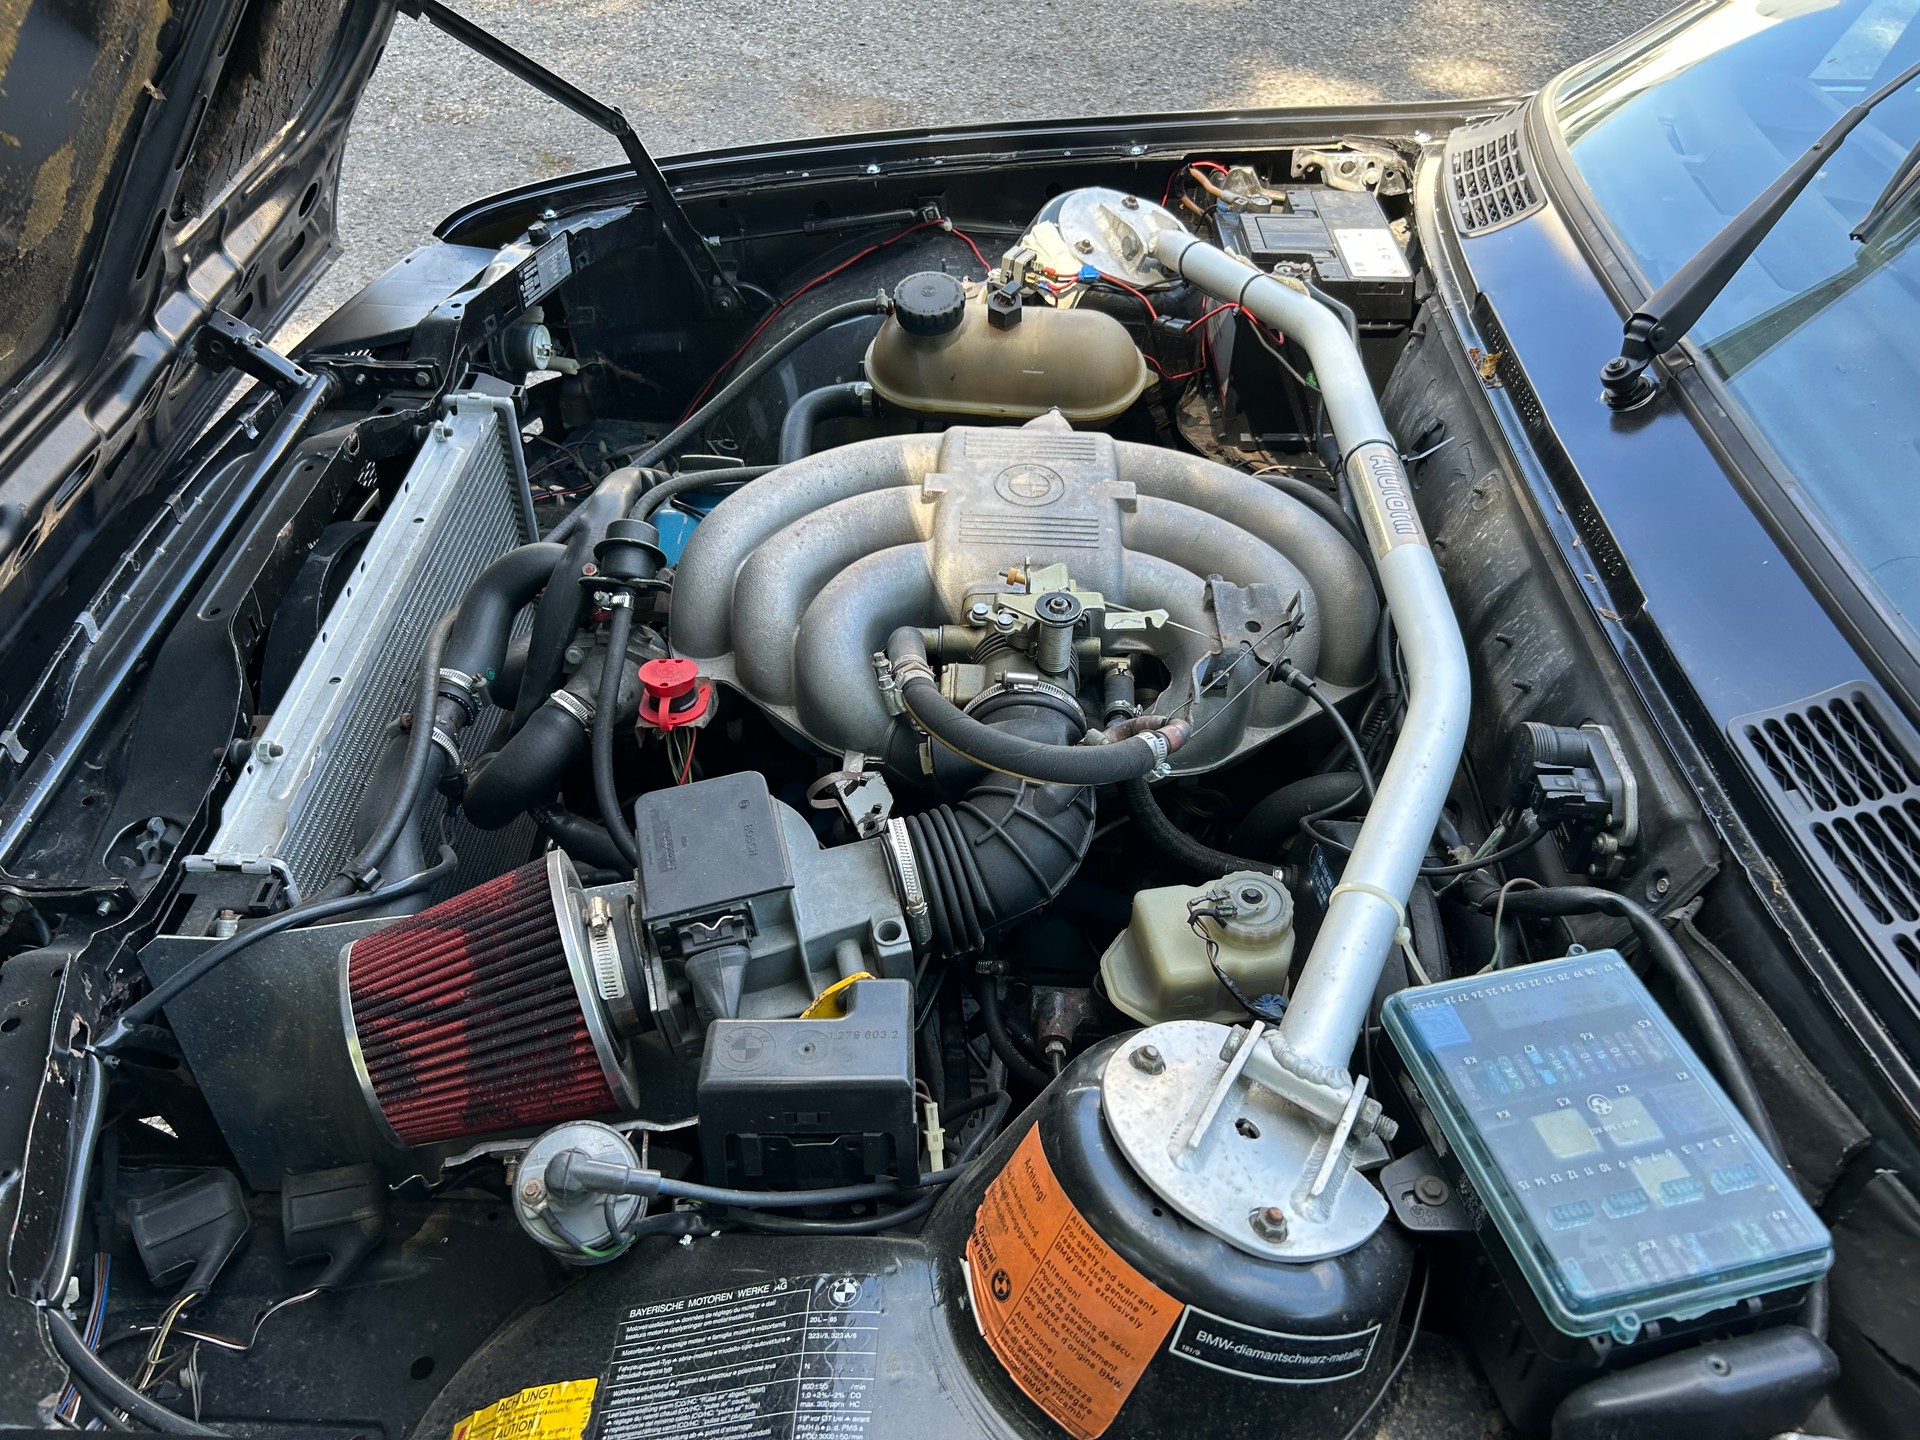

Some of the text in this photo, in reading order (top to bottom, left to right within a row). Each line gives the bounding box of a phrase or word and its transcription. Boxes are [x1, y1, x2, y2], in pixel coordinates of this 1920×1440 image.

[743, 824, 759, 857] BOSCH
[1585, 968, 1596, 976] 18
[1604, 964, 1614, 972] 17
[1557, 972, 1570, 981] 20
[1574, 970, 1584, 978] 19
[1529, 979, 1541, 987] 22
[1544, 976, 1554, 984] 21
[1500, 984, 1512, 992] 24
[1514, 982, 1527, 990] 23
[1471, 990, 1484, 998] 26
[1486, 988, 1498, 996] 25
[1444, 996, 1456, 1004] 28
[1458, 993, 1468, 1002] 27
[1426, 1000, 1437, 1008] 29
[1638, 1020, 1652, 1028] K5
[864, 1030, 887, 1040] 603
[892, 1030, 899, 1039] 2
[1580, 1032, 1594, 1040] K6
[1524, 1044, 1536, 1053] K7
[1464, 1056, 1478, 1065] K8
[1676, 1072, 1690, 1080] K1
[1616, 1084, 1630, 1094] K2
[1556, 1096, 1571, 1107] K3
[1496, 1110, 1510, 1118] K4
[1712, 1138, 1722, 1148] 3
[1729, 1134, 1738, 1144] 2
[1681, 1146, 1690, 1154] 5
[1696, 1142, 1704, 1150] 4
[1650, 1152, 1658, 1162] 7
[1664, 1148, 1672, 1158] 6
[1618, 1160, 1626, 1168] 9
[1633, 1156, 1642, 1165] 8
[1584, 1167, 1594, 1176] 11
[1599, 1162, 1612, 1172] 10
[1024, 1156, 1047, 1204] Achtung!
[1550, 1173, 1562, 1183] 13
[1566, 1170, 1579, 1180] 12
[1518, 1180, 1530, 1190] 15
[1534, 1177, 1546, 1186] 14
[1070, 1216, 1108, 1259] Attention!
[978, 1225, 996, 1264] Original
[1637, 1239, 1660, 1254] K10
[977, 1248, 988, 1272] Teile
[1060, 1234, 1140, 1312] reasons use genuine
[1064, 1224, 1159, 1316] For safety and warranty
[1044, 1259, 1082, 1300] Attention!
[1054, 1240, 1143, 1330] BMW parts exclusively.
[629, 1282, 788, 1318] BAYERISCHE MOTOREN WERKE AG
[1039, 1268, 1055, 1288] Pour
[1054, 1287, 1068, 1304] des
[1068, 1302, 1098, 1332] raisons
[1098, 1330, 1110, 1342] de
[1034, 1278, 1097, 1344] rité et de garantie
[1014, 1310, 1057, 1358] Attenzione!
[1029, 1286, 1060, 1323] employez
[1061, 1322, 1118, 1372] exclusivement
[1024, 1296, 1124, 1389] des pièces d'origine BMW
[1196, 1329, 1364, 1364] BMW-diamantschwarz-metallic
[804, 1362, 811, 1370] N
[1008, 1318, 1022, 1335] Per
[1021, 1334, 1046, 1362] ragioni
[1046, 1361, 1054, 1370] di
[1054, 1368, 1092, 1404] sicurezza
[1000, 1336, 1051, 1392] esclusivamente
[1052, 1392, 1084, 1421] ricambi
[1010, 1336, 1016, 1346] di
[1016, 1344, 1050, 1378] garanzia
[1050, 1376, 1093, 1416] impiegare
[1022, 1373, 1044, 1395] BMW
